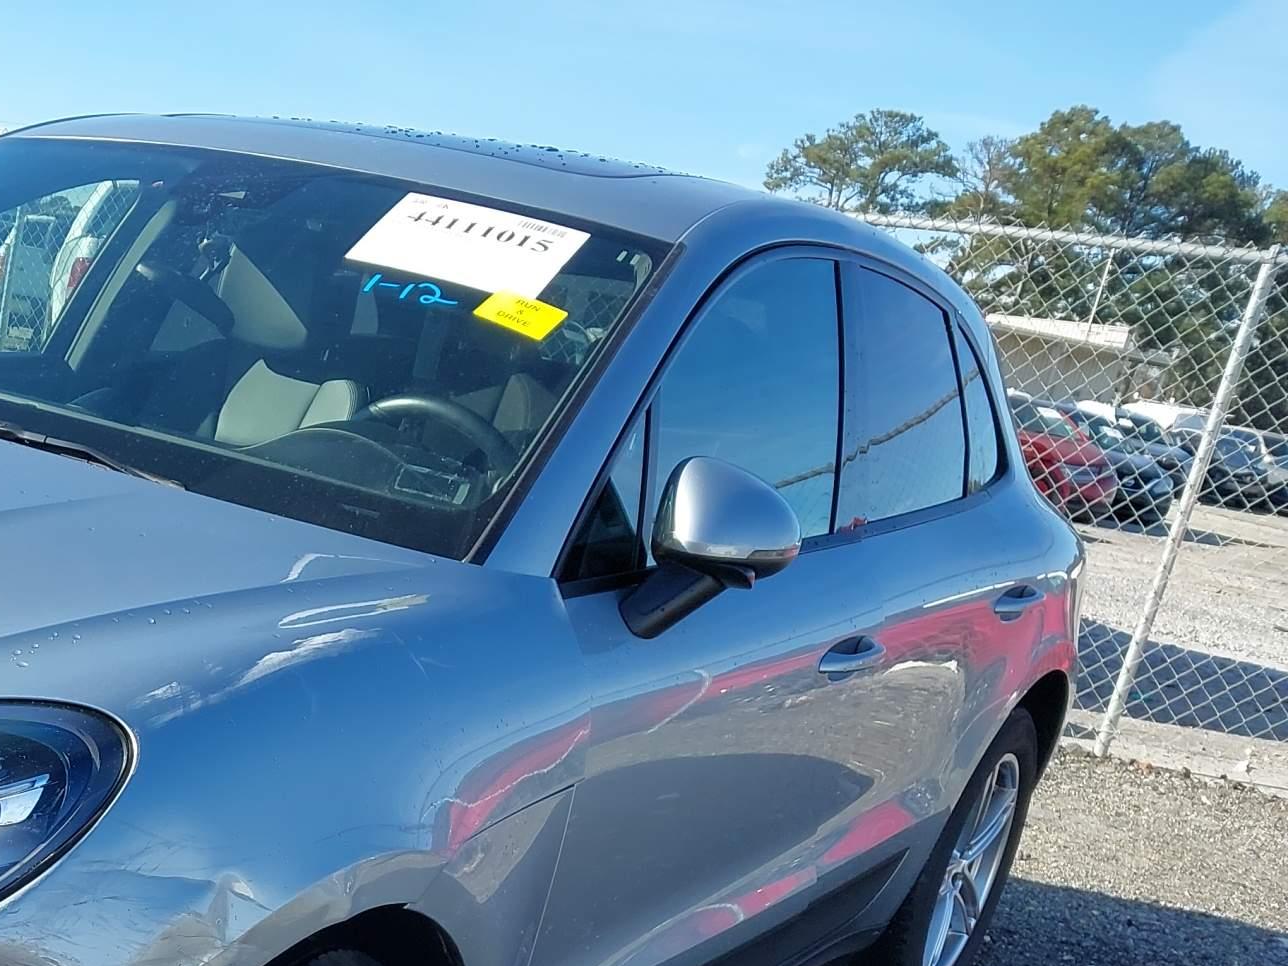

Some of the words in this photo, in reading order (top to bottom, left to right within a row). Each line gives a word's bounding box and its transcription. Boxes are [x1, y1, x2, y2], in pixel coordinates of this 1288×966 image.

[407, 210, 554, 253] 44111015
[363, 273, 459, 305] 1-12
[515, 299, 541, 312] RUN
[496, 310, 530, 328] DRIVE
